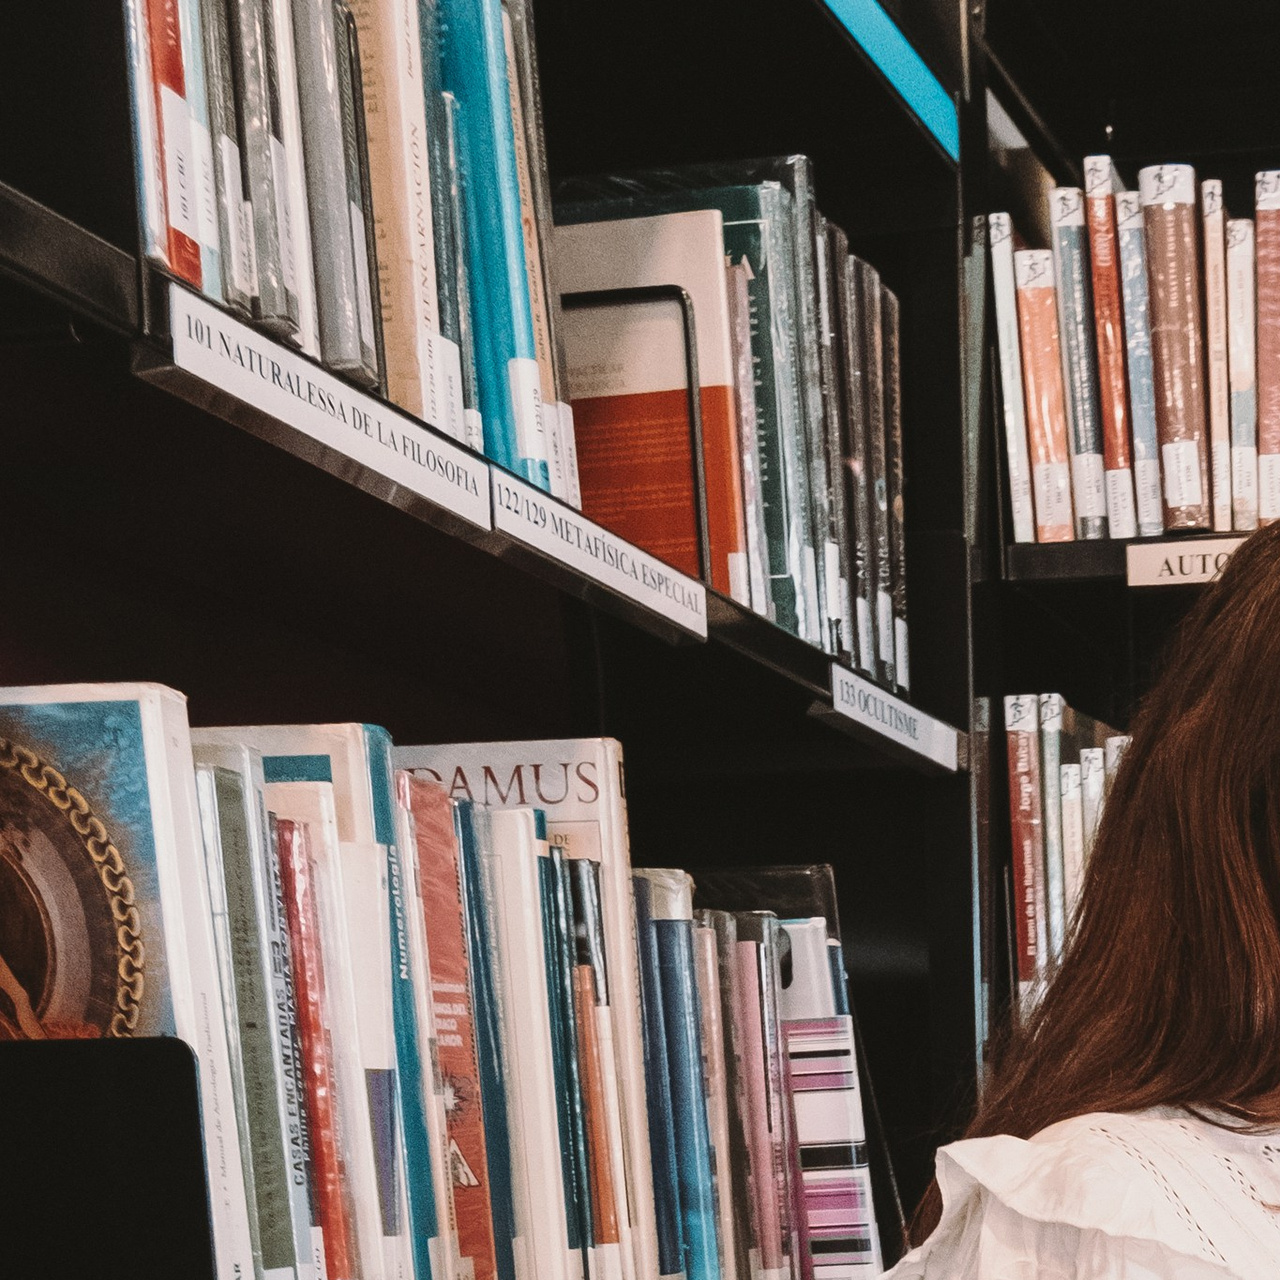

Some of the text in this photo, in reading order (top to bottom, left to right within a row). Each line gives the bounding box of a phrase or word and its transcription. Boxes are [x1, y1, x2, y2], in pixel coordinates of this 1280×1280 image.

[187, 314, 479, 497] 101 NATURALESSA DE LA FILOSOFIA
[533, 387, 545, 434] 122/129
[497, 482, 703, 617] 122/129 METAFÍSICA ESPECIAL
[840, 679, 920, 740] 133 OCULTISME
[1015, 732, 1032, 811] Jorge Bucay
[388, 844, 410, 979] Numerología
[1027, 945, 1036, 956] El
[275, 987, 307, 1186] CASAS ENCANTADAS
